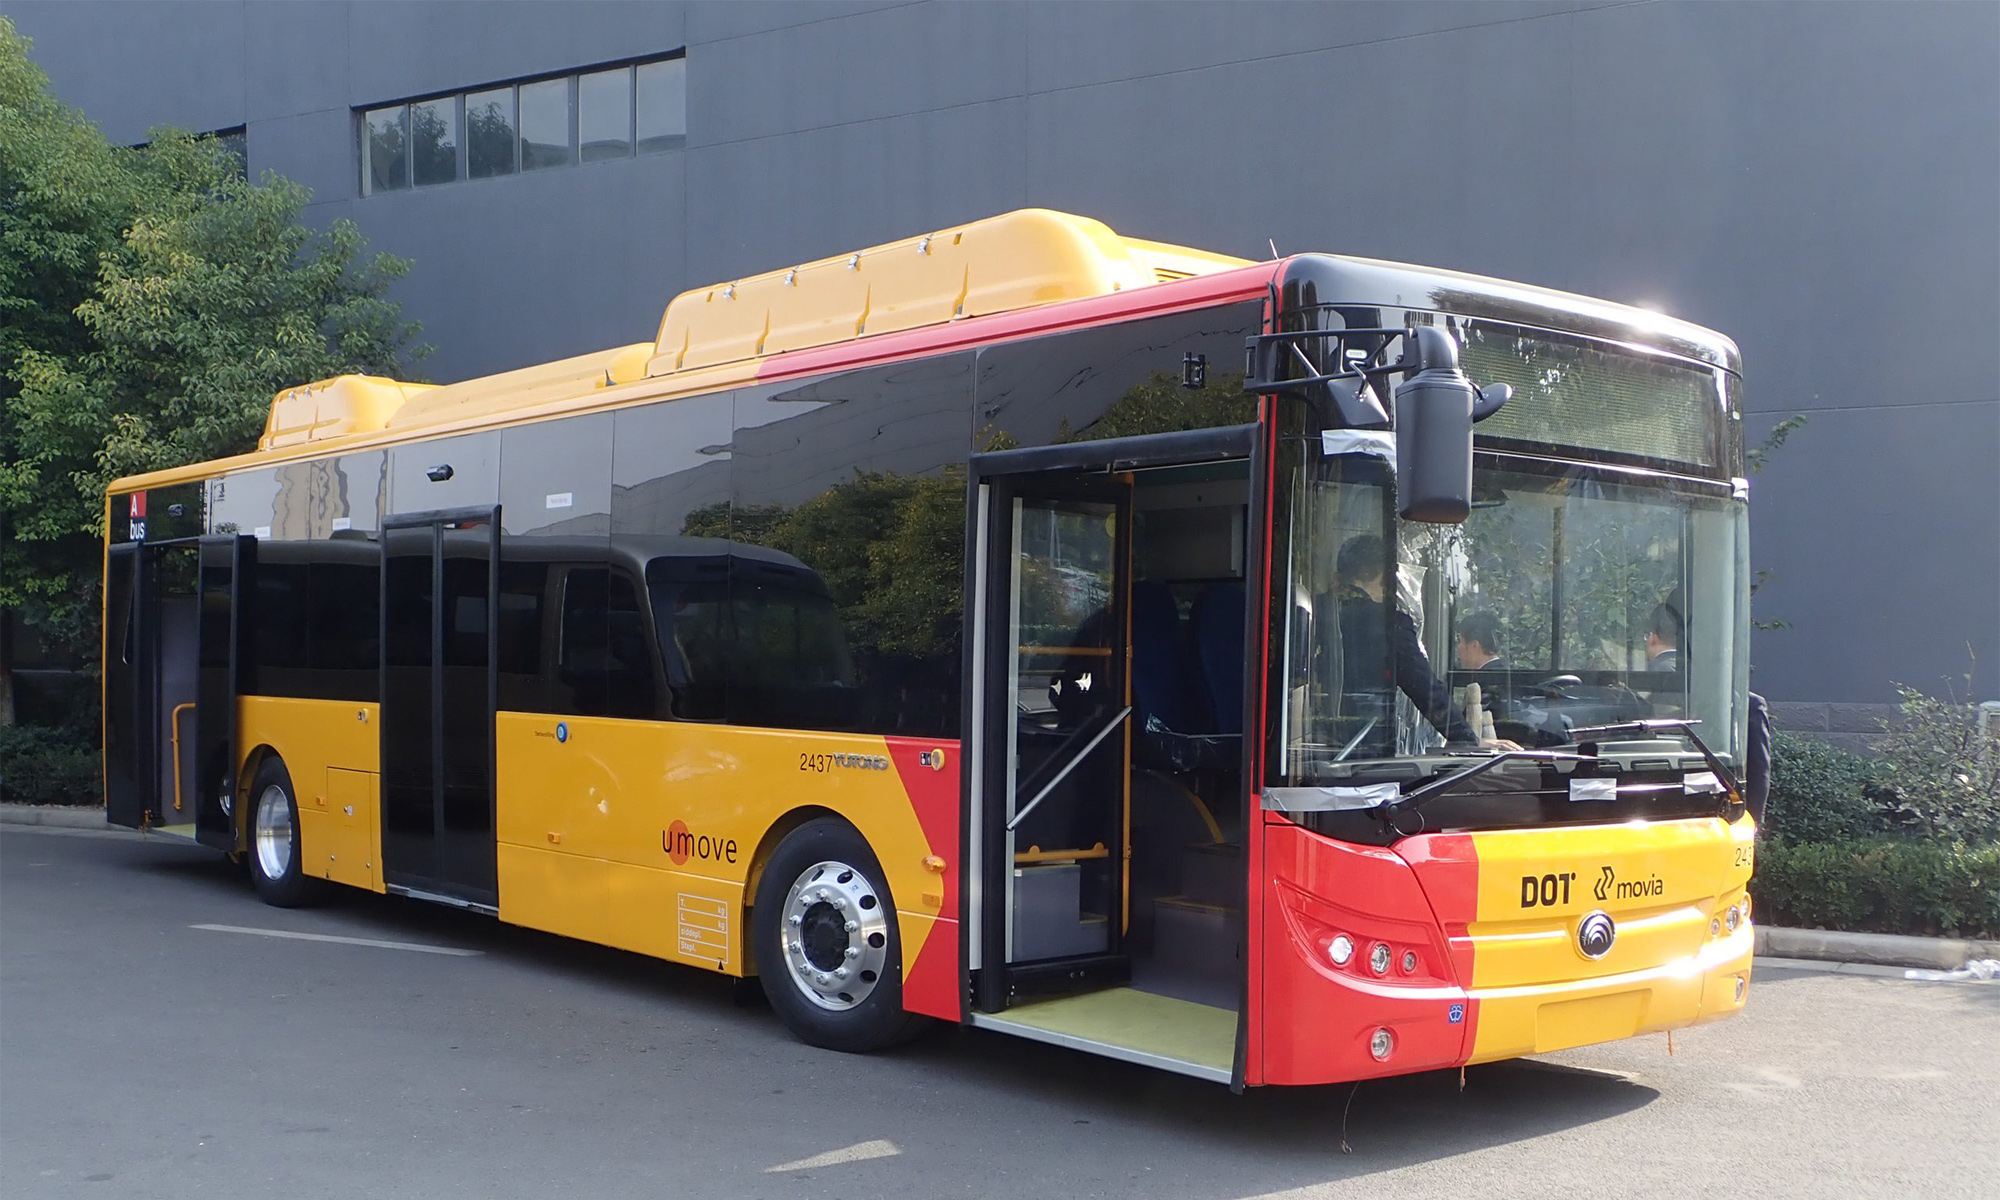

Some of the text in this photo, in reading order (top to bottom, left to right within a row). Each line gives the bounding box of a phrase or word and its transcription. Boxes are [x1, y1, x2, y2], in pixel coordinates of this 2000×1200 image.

[130, 494, 138, 517] A
[130, 518, 145, 540] bus
[800, 752, 833, 773] 2437
[833, 751, 889, 771] YUTONG
[1617, 873, 1663, 899] movia
